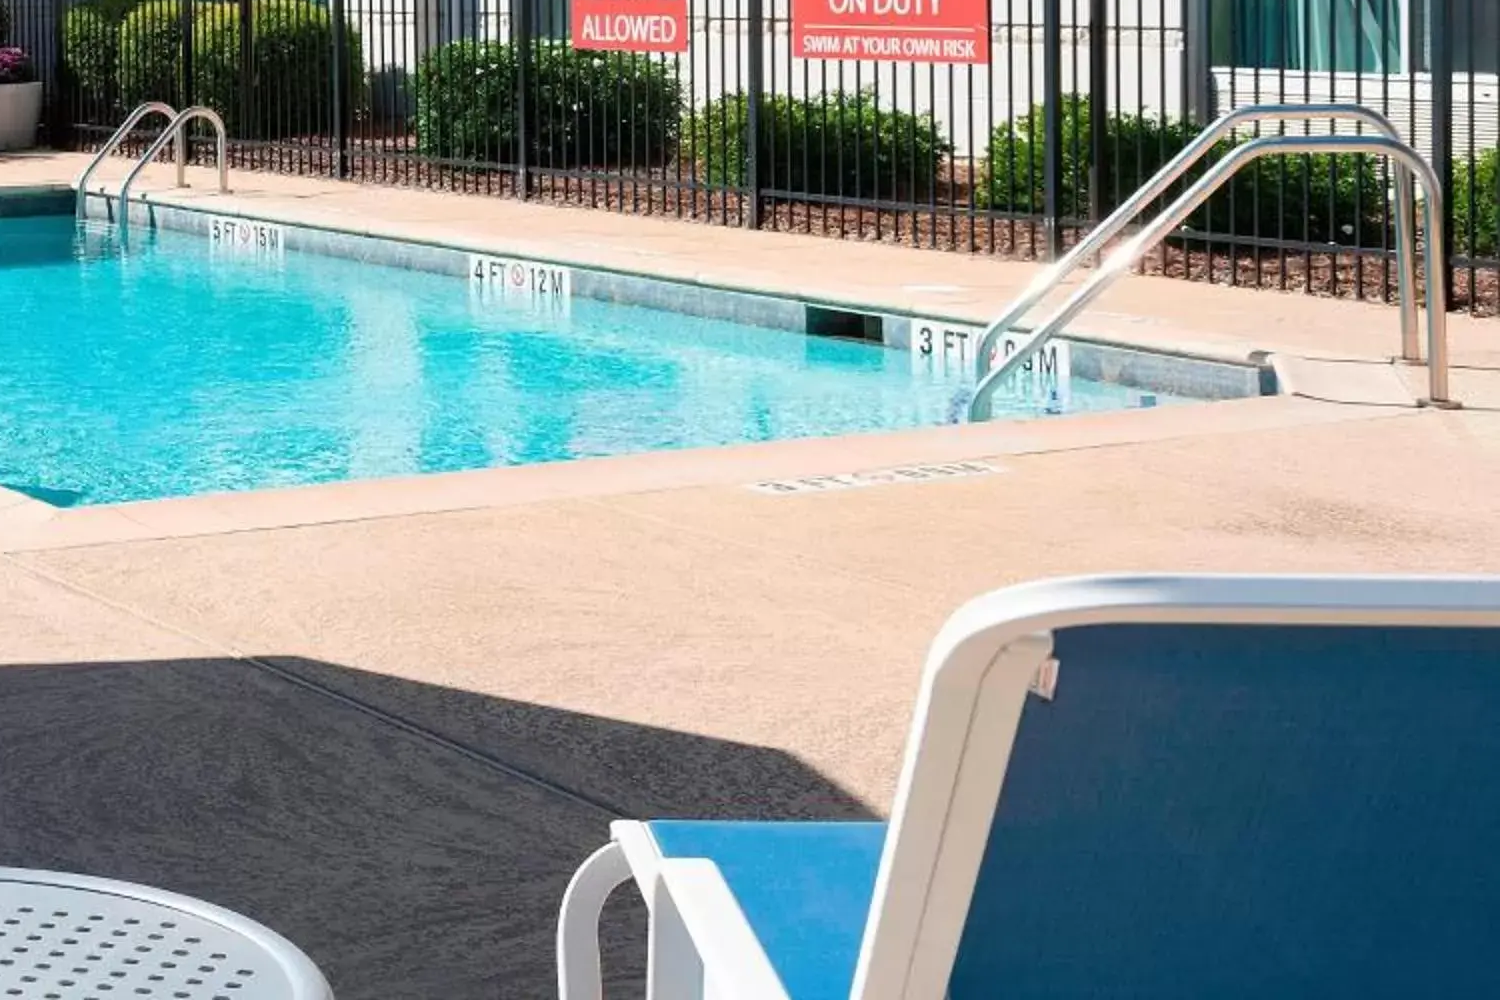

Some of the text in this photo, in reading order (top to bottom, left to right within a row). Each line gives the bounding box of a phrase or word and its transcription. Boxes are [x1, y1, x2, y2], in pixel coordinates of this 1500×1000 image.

[581, 14, 677, 43] ALLOWED
[803, 35, 975, 58] SWIM AT YOUR OWN RISK
[224, 221, 236, 247] FT
[475, 260, 484, 280] 4
[490, 262, 506, 287] FT
[920, 327, 932, 355] 3
[944, 330, 968, 360] FT
